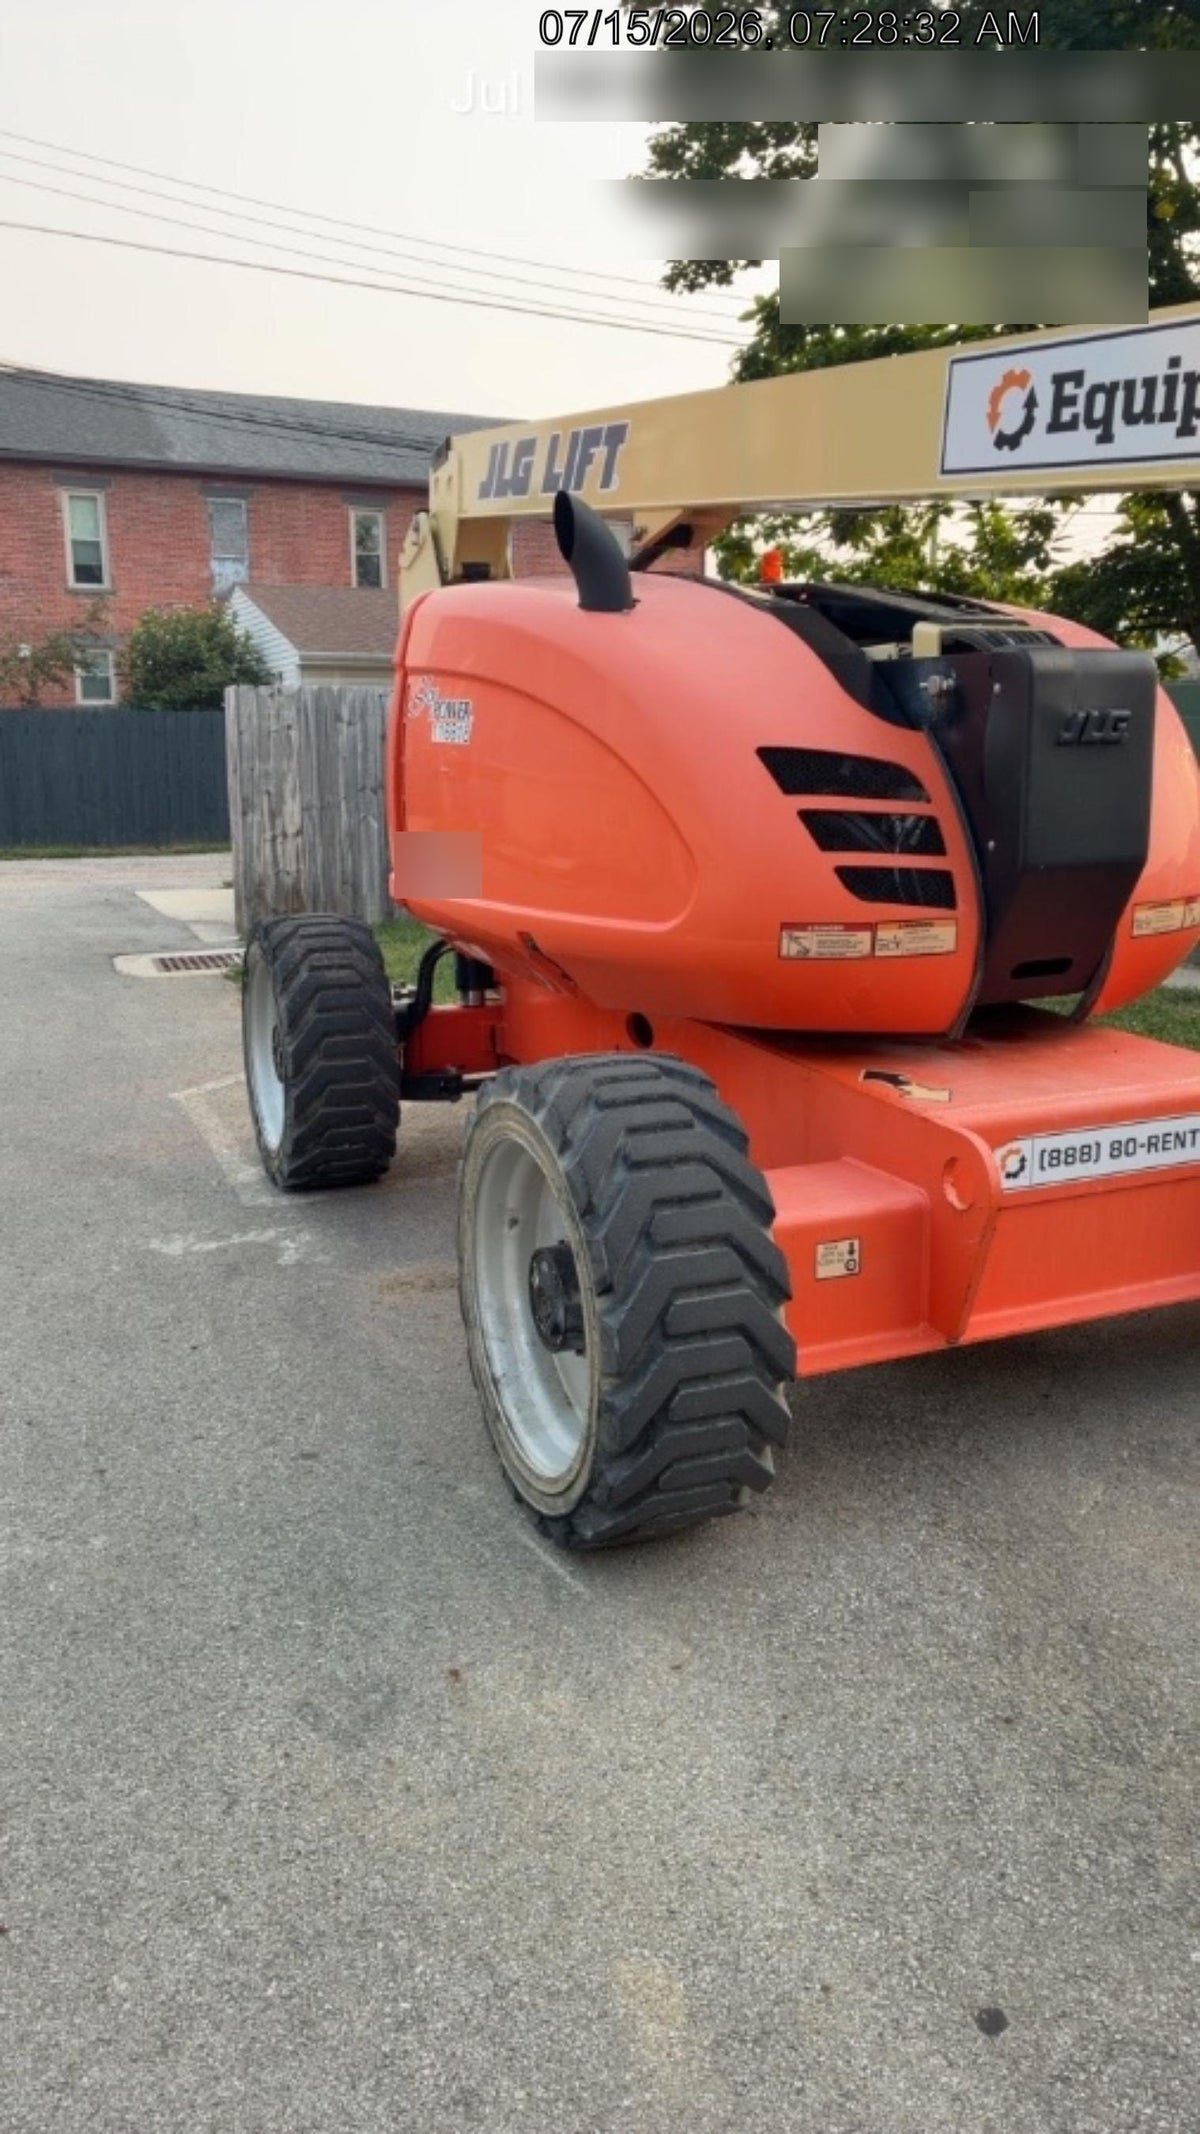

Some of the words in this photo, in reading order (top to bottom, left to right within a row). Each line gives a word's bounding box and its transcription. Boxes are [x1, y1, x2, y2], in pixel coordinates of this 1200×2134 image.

[477, 437, 537, 500] JLG
[541, 420, 631, 495] LIFT
[1055, 708, 1132, 747] JLG
[1038, 1140, 1101, 1171] (888)
[1109, 1128, 1200, 1160] 80-RENT
